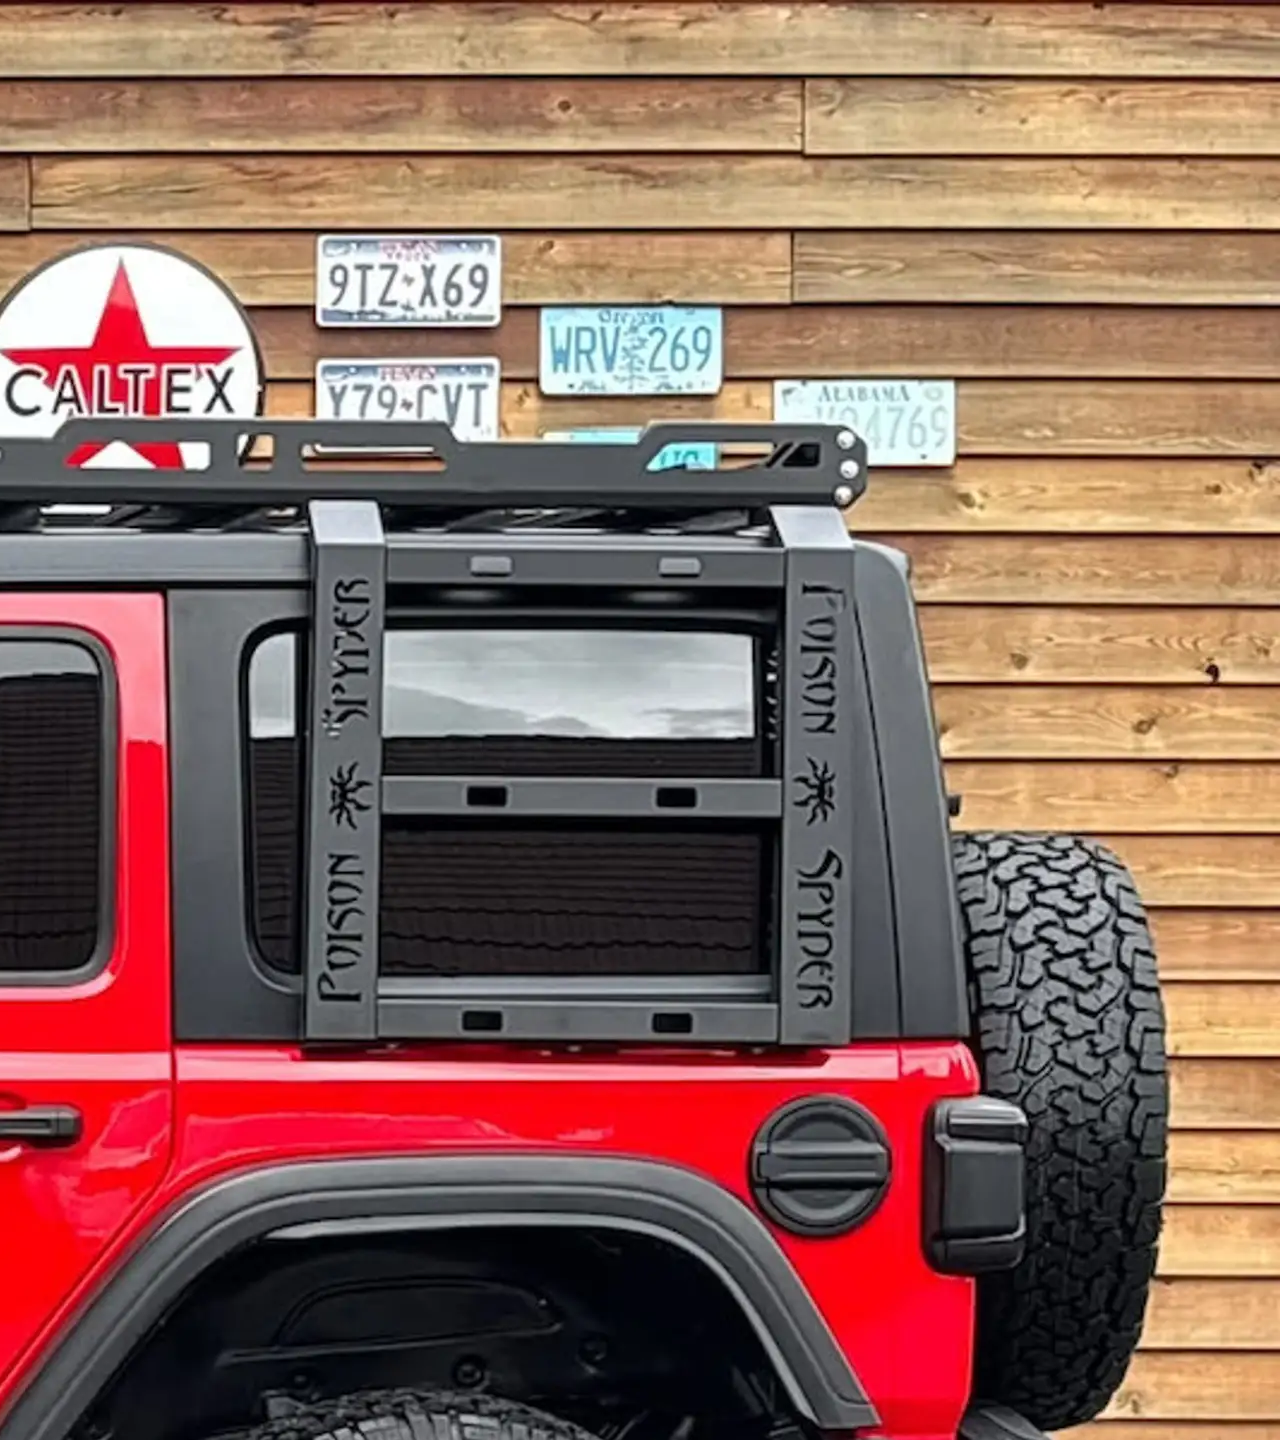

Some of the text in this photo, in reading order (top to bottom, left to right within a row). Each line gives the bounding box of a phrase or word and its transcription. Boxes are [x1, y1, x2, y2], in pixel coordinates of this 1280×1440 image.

[4, 367, 235, 417] CALTEX
[550, 326, 713, 374] WRV 269
[317, 577, 371, 1003] POISON SPYDER
[796, 582, 846, 1010] POISON SPYDER
